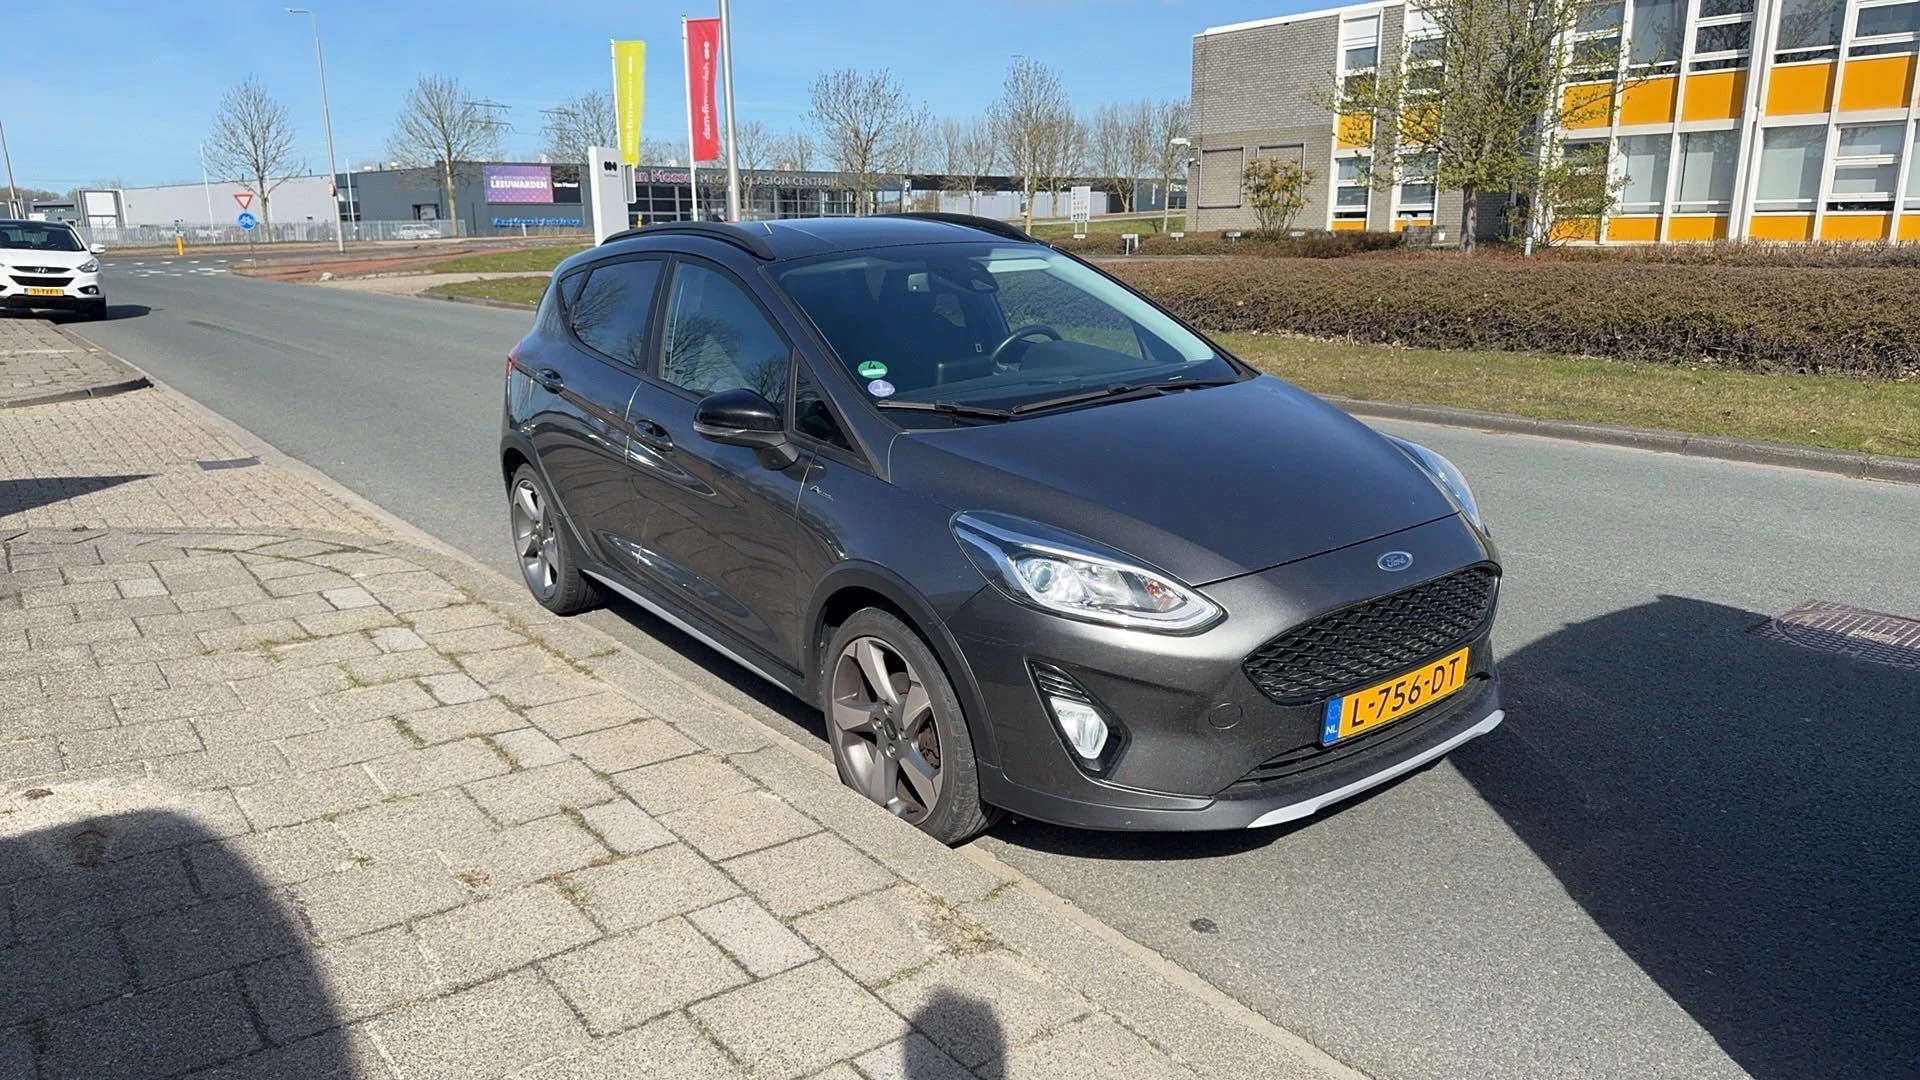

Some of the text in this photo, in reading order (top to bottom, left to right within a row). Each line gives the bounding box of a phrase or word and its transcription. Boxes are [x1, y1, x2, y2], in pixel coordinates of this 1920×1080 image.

[651, 169, 692, 183] Mosse
[490, 180, 548, 190] LEEUWARDEN
[1351, 656, 1460, 728] L-756-DT
[1325, 725, 1338, 736] NL
